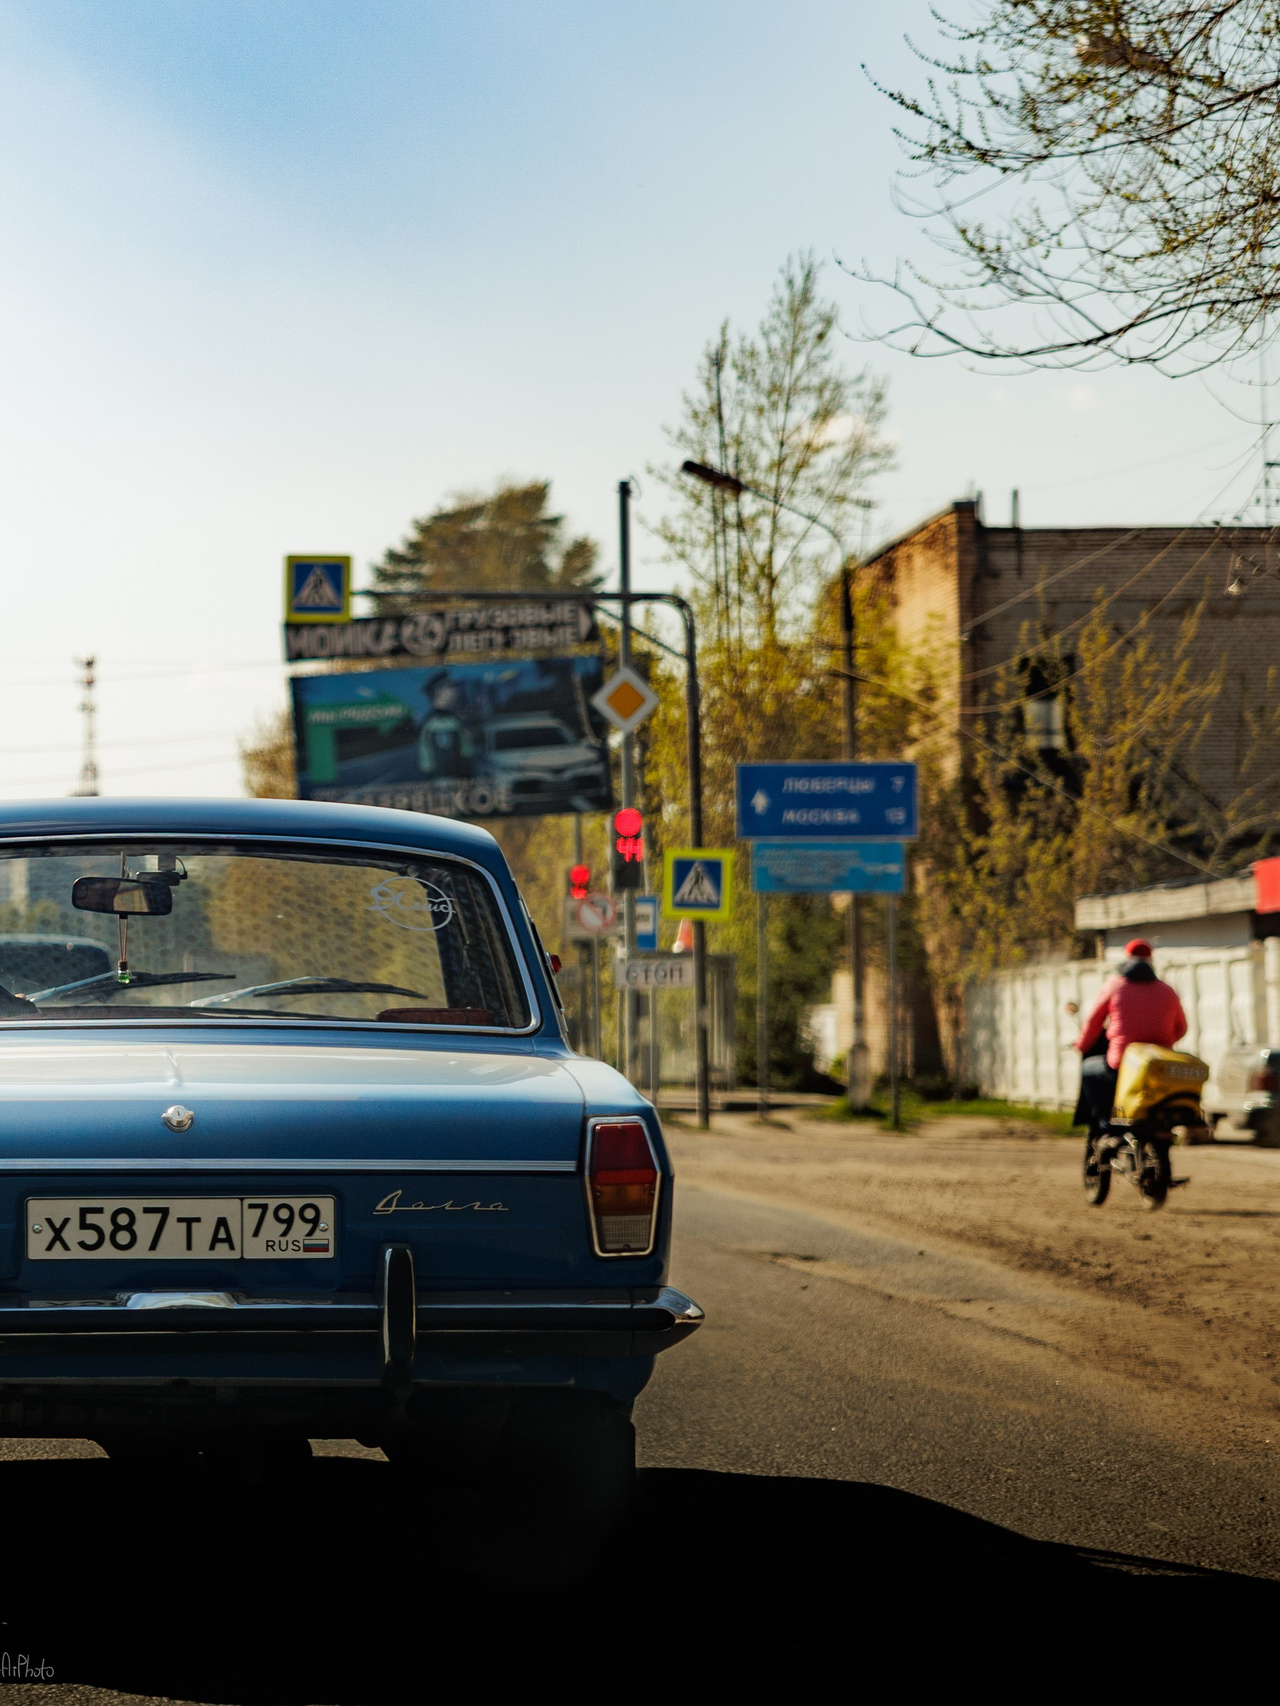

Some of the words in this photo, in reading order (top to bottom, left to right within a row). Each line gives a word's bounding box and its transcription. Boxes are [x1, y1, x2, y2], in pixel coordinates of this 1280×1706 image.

[782, 807, 861, 825] МОСКВА
[625, 960, 683, 986] СТОП
[247, 1202, 321, 1238] 799
[265, 1239, 301, 1253] RUS
